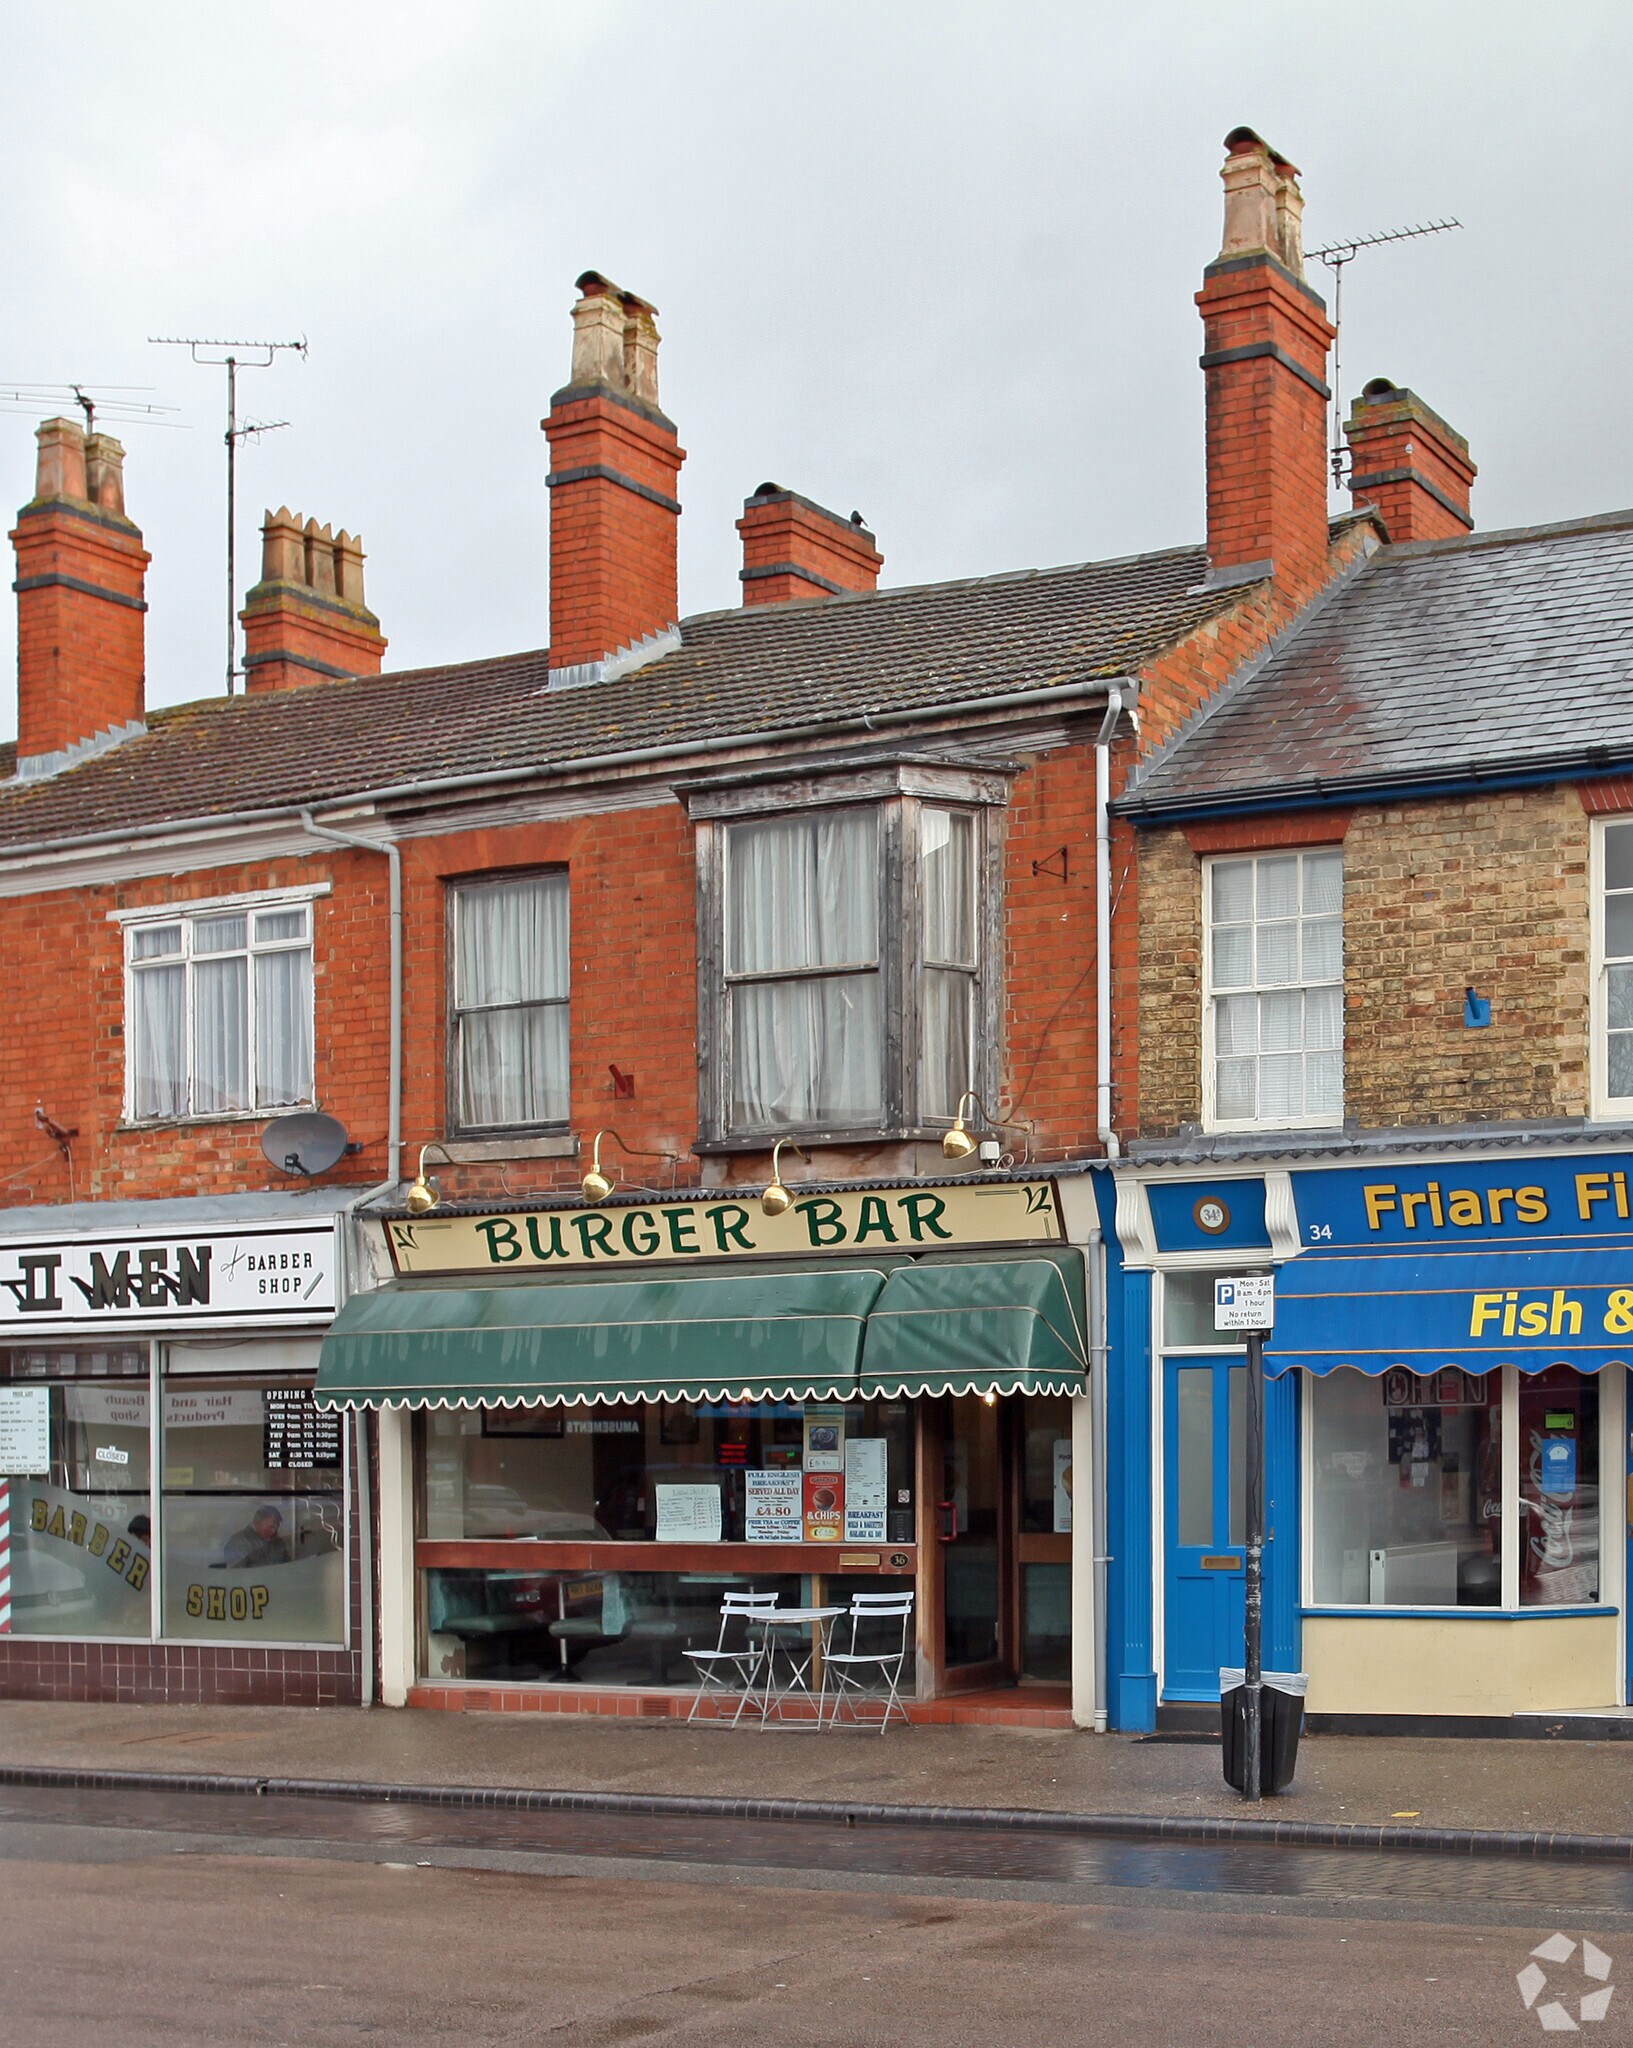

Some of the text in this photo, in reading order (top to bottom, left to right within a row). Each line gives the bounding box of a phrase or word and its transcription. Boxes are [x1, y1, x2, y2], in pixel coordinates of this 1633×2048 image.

[1363, 1181, 1548, 1230] Friars
[475, 1192, 953, 1263] BURGER BAR
[1309, 1224, 1333, 1241] 34
[247, 1252, 313, 1271] BARBER
[84, 1245, 213, 1310] MEN
[258, 1277, 302, 1294] SHOP
[1469, 1289, 1633, 1337] Fish &
[266, 1390, 305, 1400] OPENING
[97, 1450, 126, 1462] CLOSED
[756, 1506, 791, 1516] £4.80
[31, 1498, 151, 1591] BARBER
[893, 1555, 906, 1566] 36
[186, 1583, 269, 1620] SHOP
